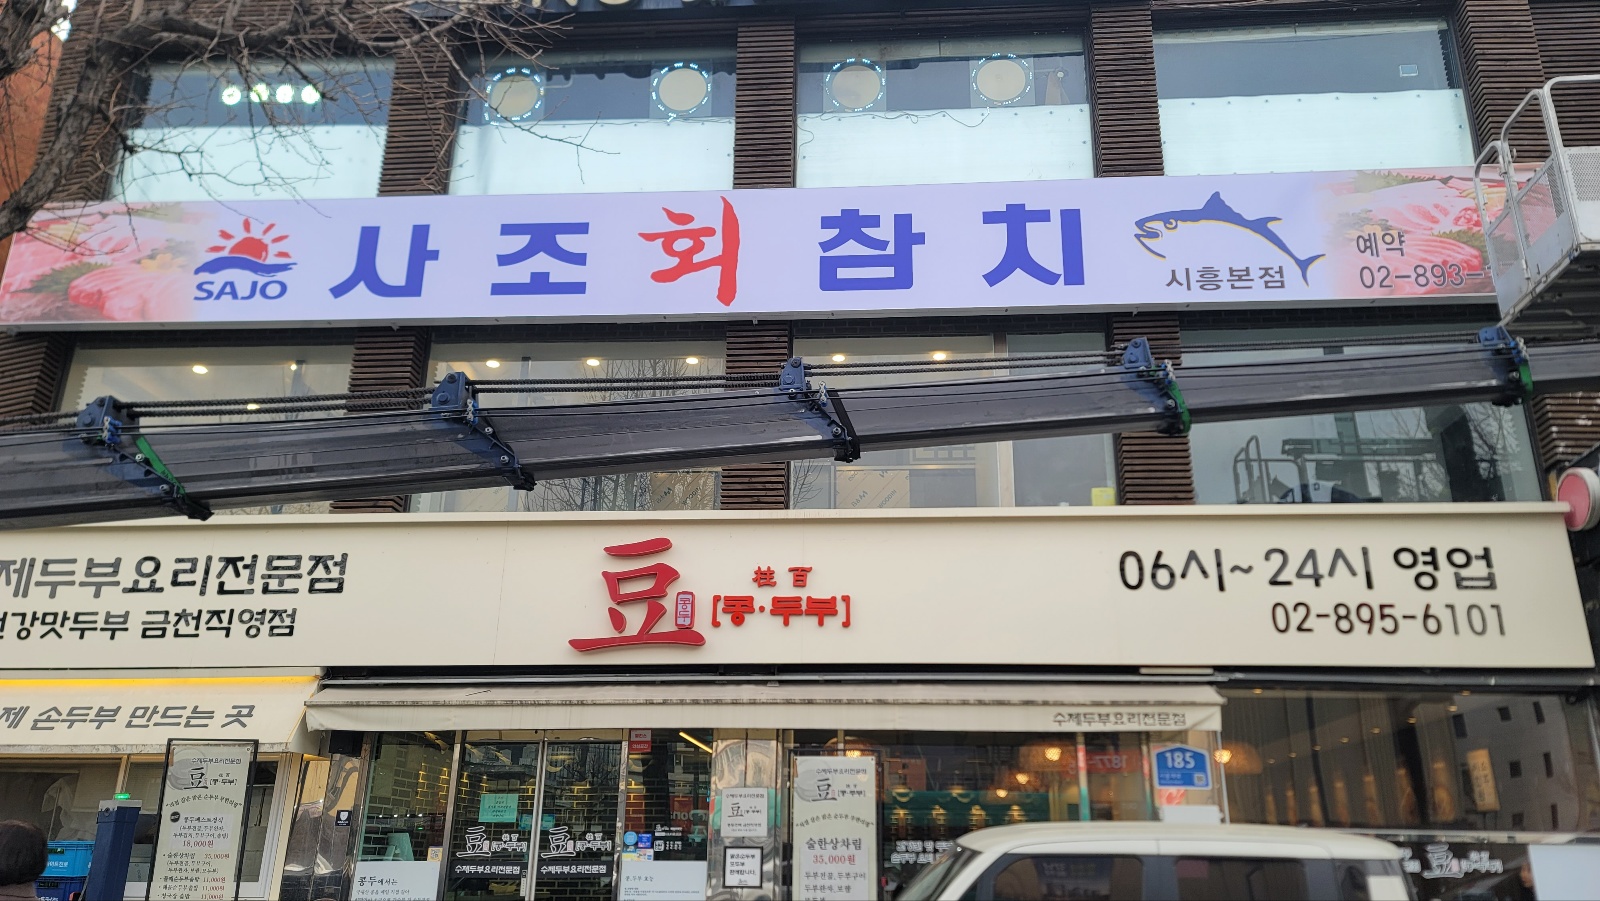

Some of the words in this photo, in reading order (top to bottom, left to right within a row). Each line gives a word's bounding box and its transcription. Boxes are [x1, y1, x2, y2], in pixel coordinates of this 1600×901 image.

[1356, 231, 1406, 258] 예약
[193, 280, 288, 301] SAJO
[1166, 265, 1286, 291] 시흥본점
[0, 552, 349, 599] 제두부요리전문점
[1393, 546, 1499, 592] 영업
[568, 537, 706, 653] 豆
[141, 607, 297, 639] 금천직영점
[1271, 602, 1506, 636] 02-895-6101
[30, 705, 122, 731] 손두부
[125, 705, 216, 729] 만드는
[221, 704, 256, 729] 곳
[1053, 712, 1187, 727] 수제두부요리전문점
[1165, 752, 1196, 769] 185
[183, 767, 208, 789] 豆
[811, 778, 838, 802] 豆
[183, 840, 214, 849] 18,000원
[456, 826, 492, 858] 豆
[540, 826, 577, 859] 豆
[805, 837, 862, 851] 술한상차림
[454, 864, 521, 875] 수제두부요리전문점
[540, 864, 607, 874] 수제두부요리전문점
[812, 854, 856, 866] 35,000원
